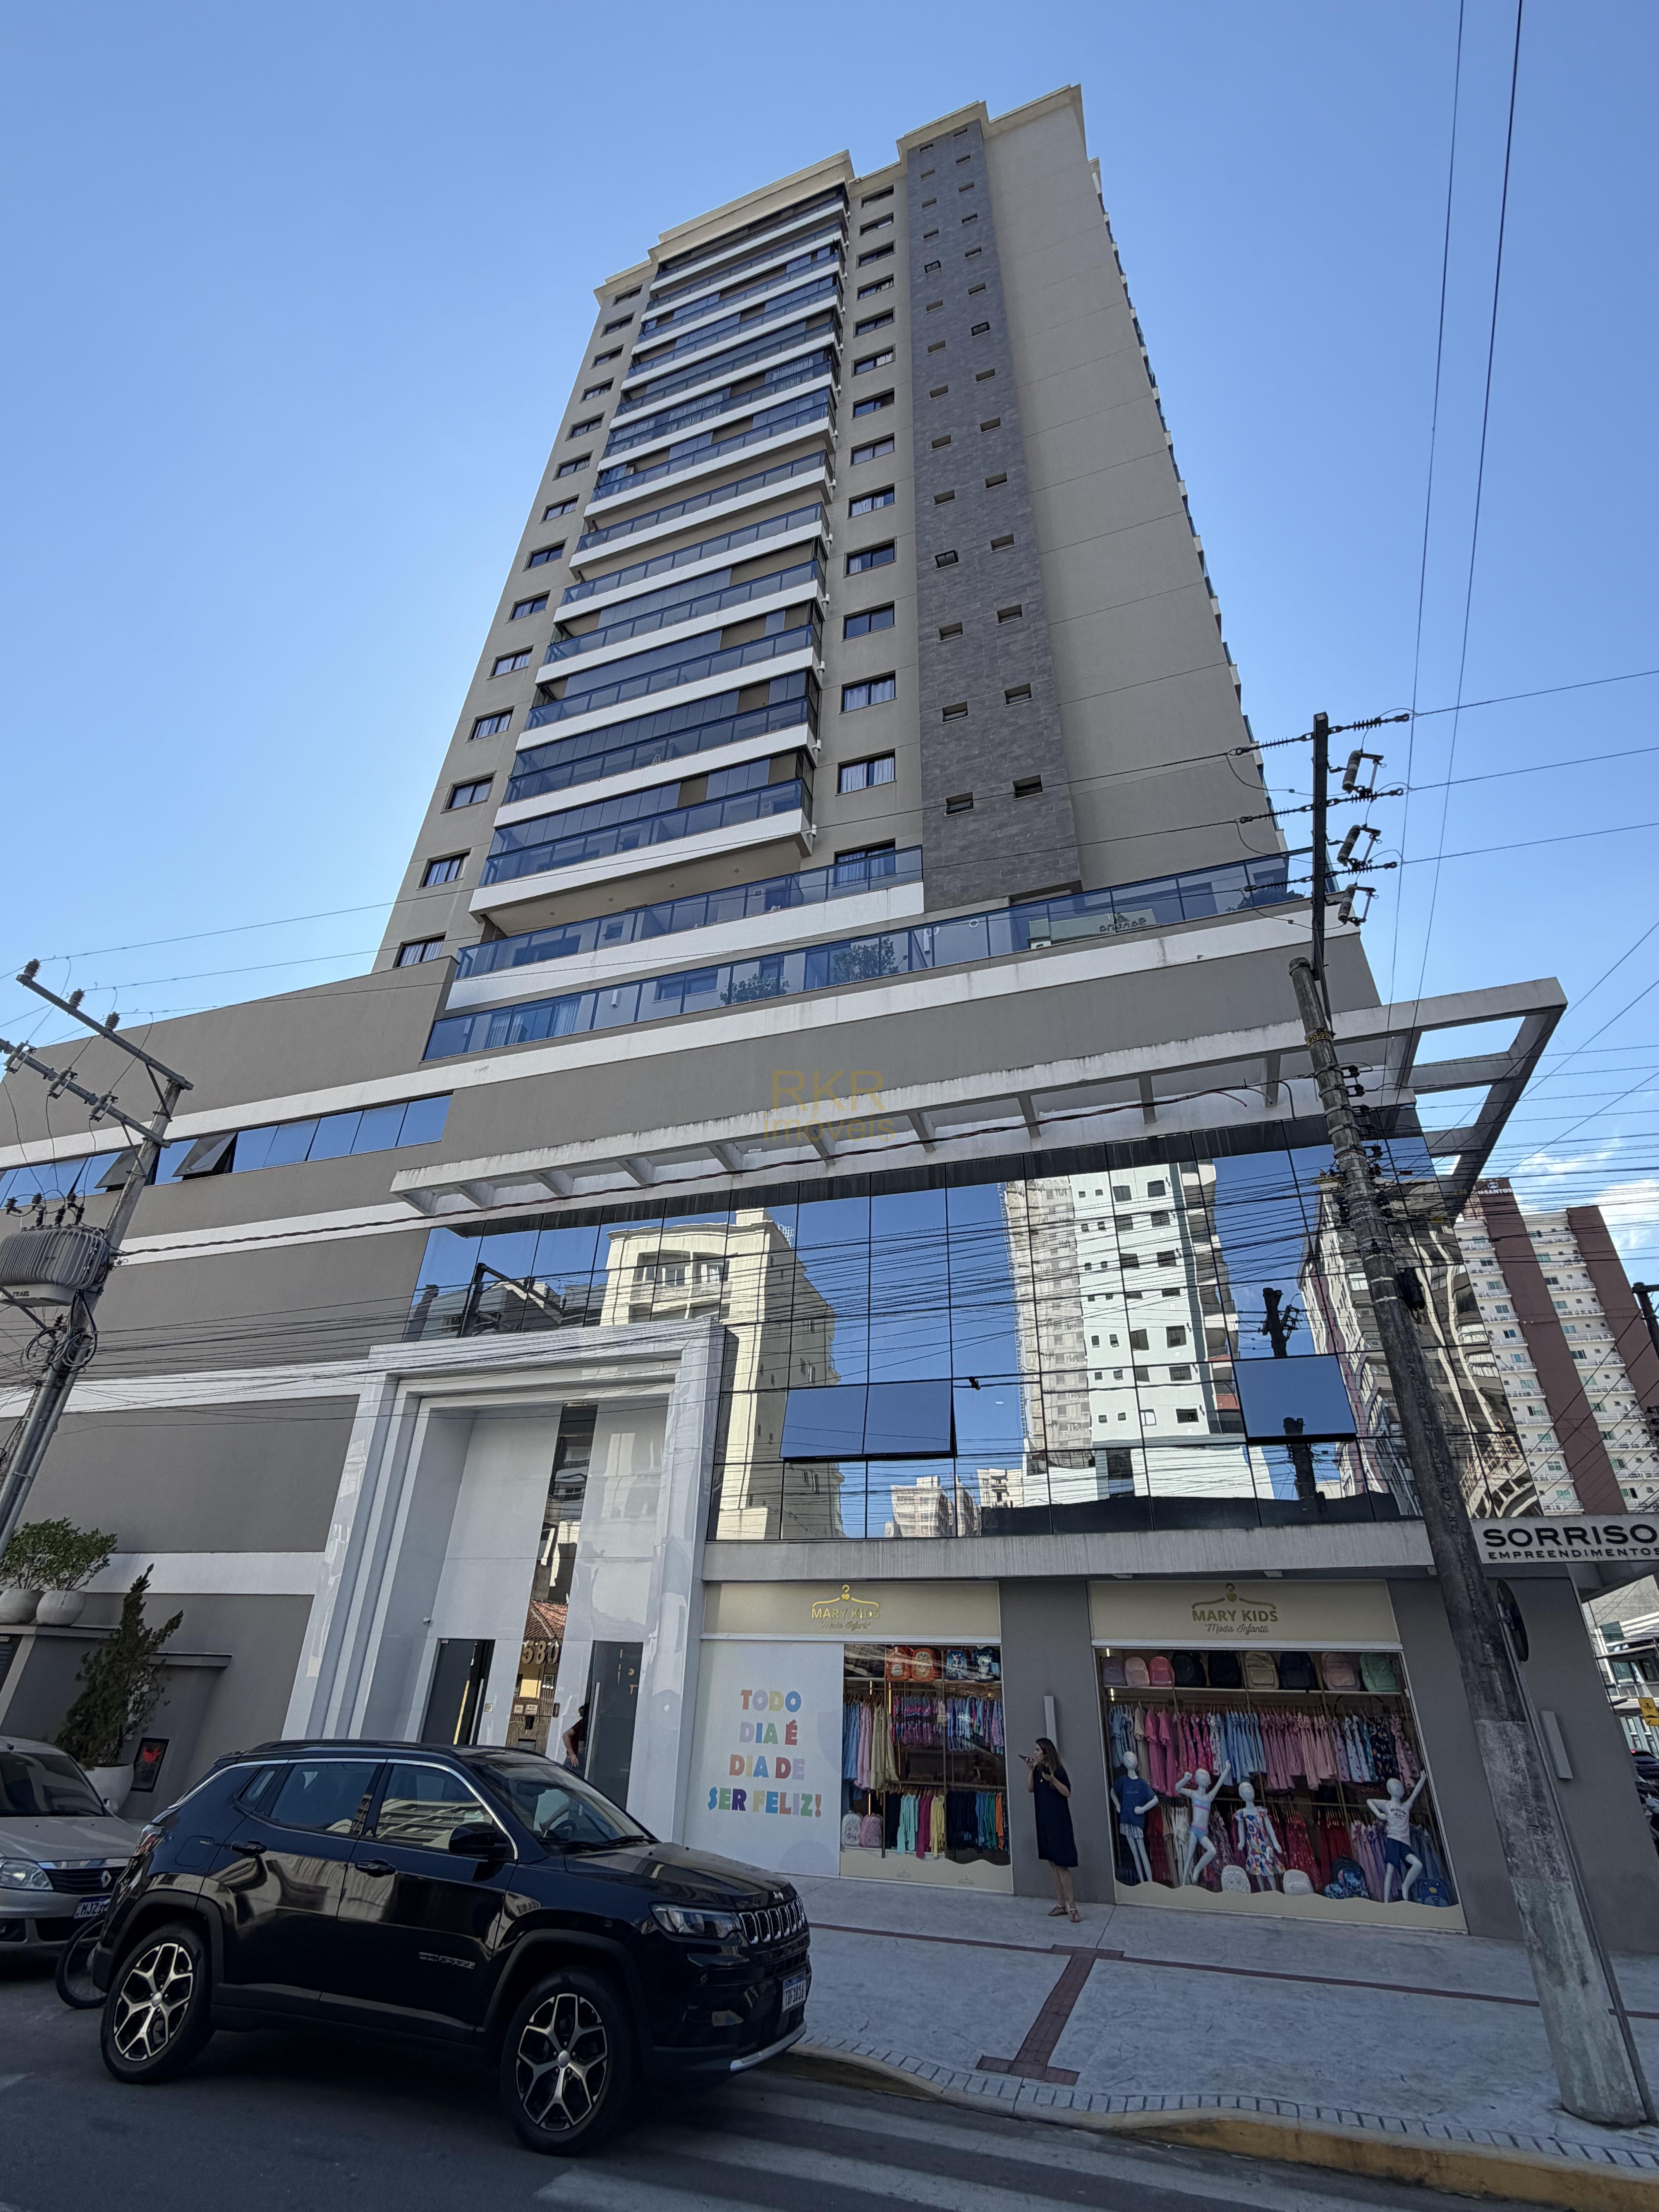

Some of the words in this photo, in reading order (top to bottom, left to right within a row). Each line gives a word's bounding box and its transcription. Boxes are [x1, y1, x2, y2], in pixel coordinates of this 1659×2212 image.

[1483, 1524, 1657, 1547] SORRISO
[1489, 1547, 1659, 1559] EMPREENDIMENTOS
[812, 1608, 847, 1618] MARY
[852, 1608, 879, 1619] KIDS
[1192, 1610, 1236, 1621] MARY
[1241, 1610, 1278, 1622] KIDS
[1204, 1623, 1235, 1634] Moda
[1237, 1623, 1269, 1635] Infantil
[522, 1640, 559, 1665] 580
[740, 1689, 802, 1713] TODO
[739, 1722, 779, 1745] DIA
[785, 1719, 798, 1745] É
[729, 1754, 769, 1778] DIA
[775, 1757, 805, 1780] DE
[708, 1786, 747, 1812] SER
[752, 1790, 822, 1818] FELIZ!
